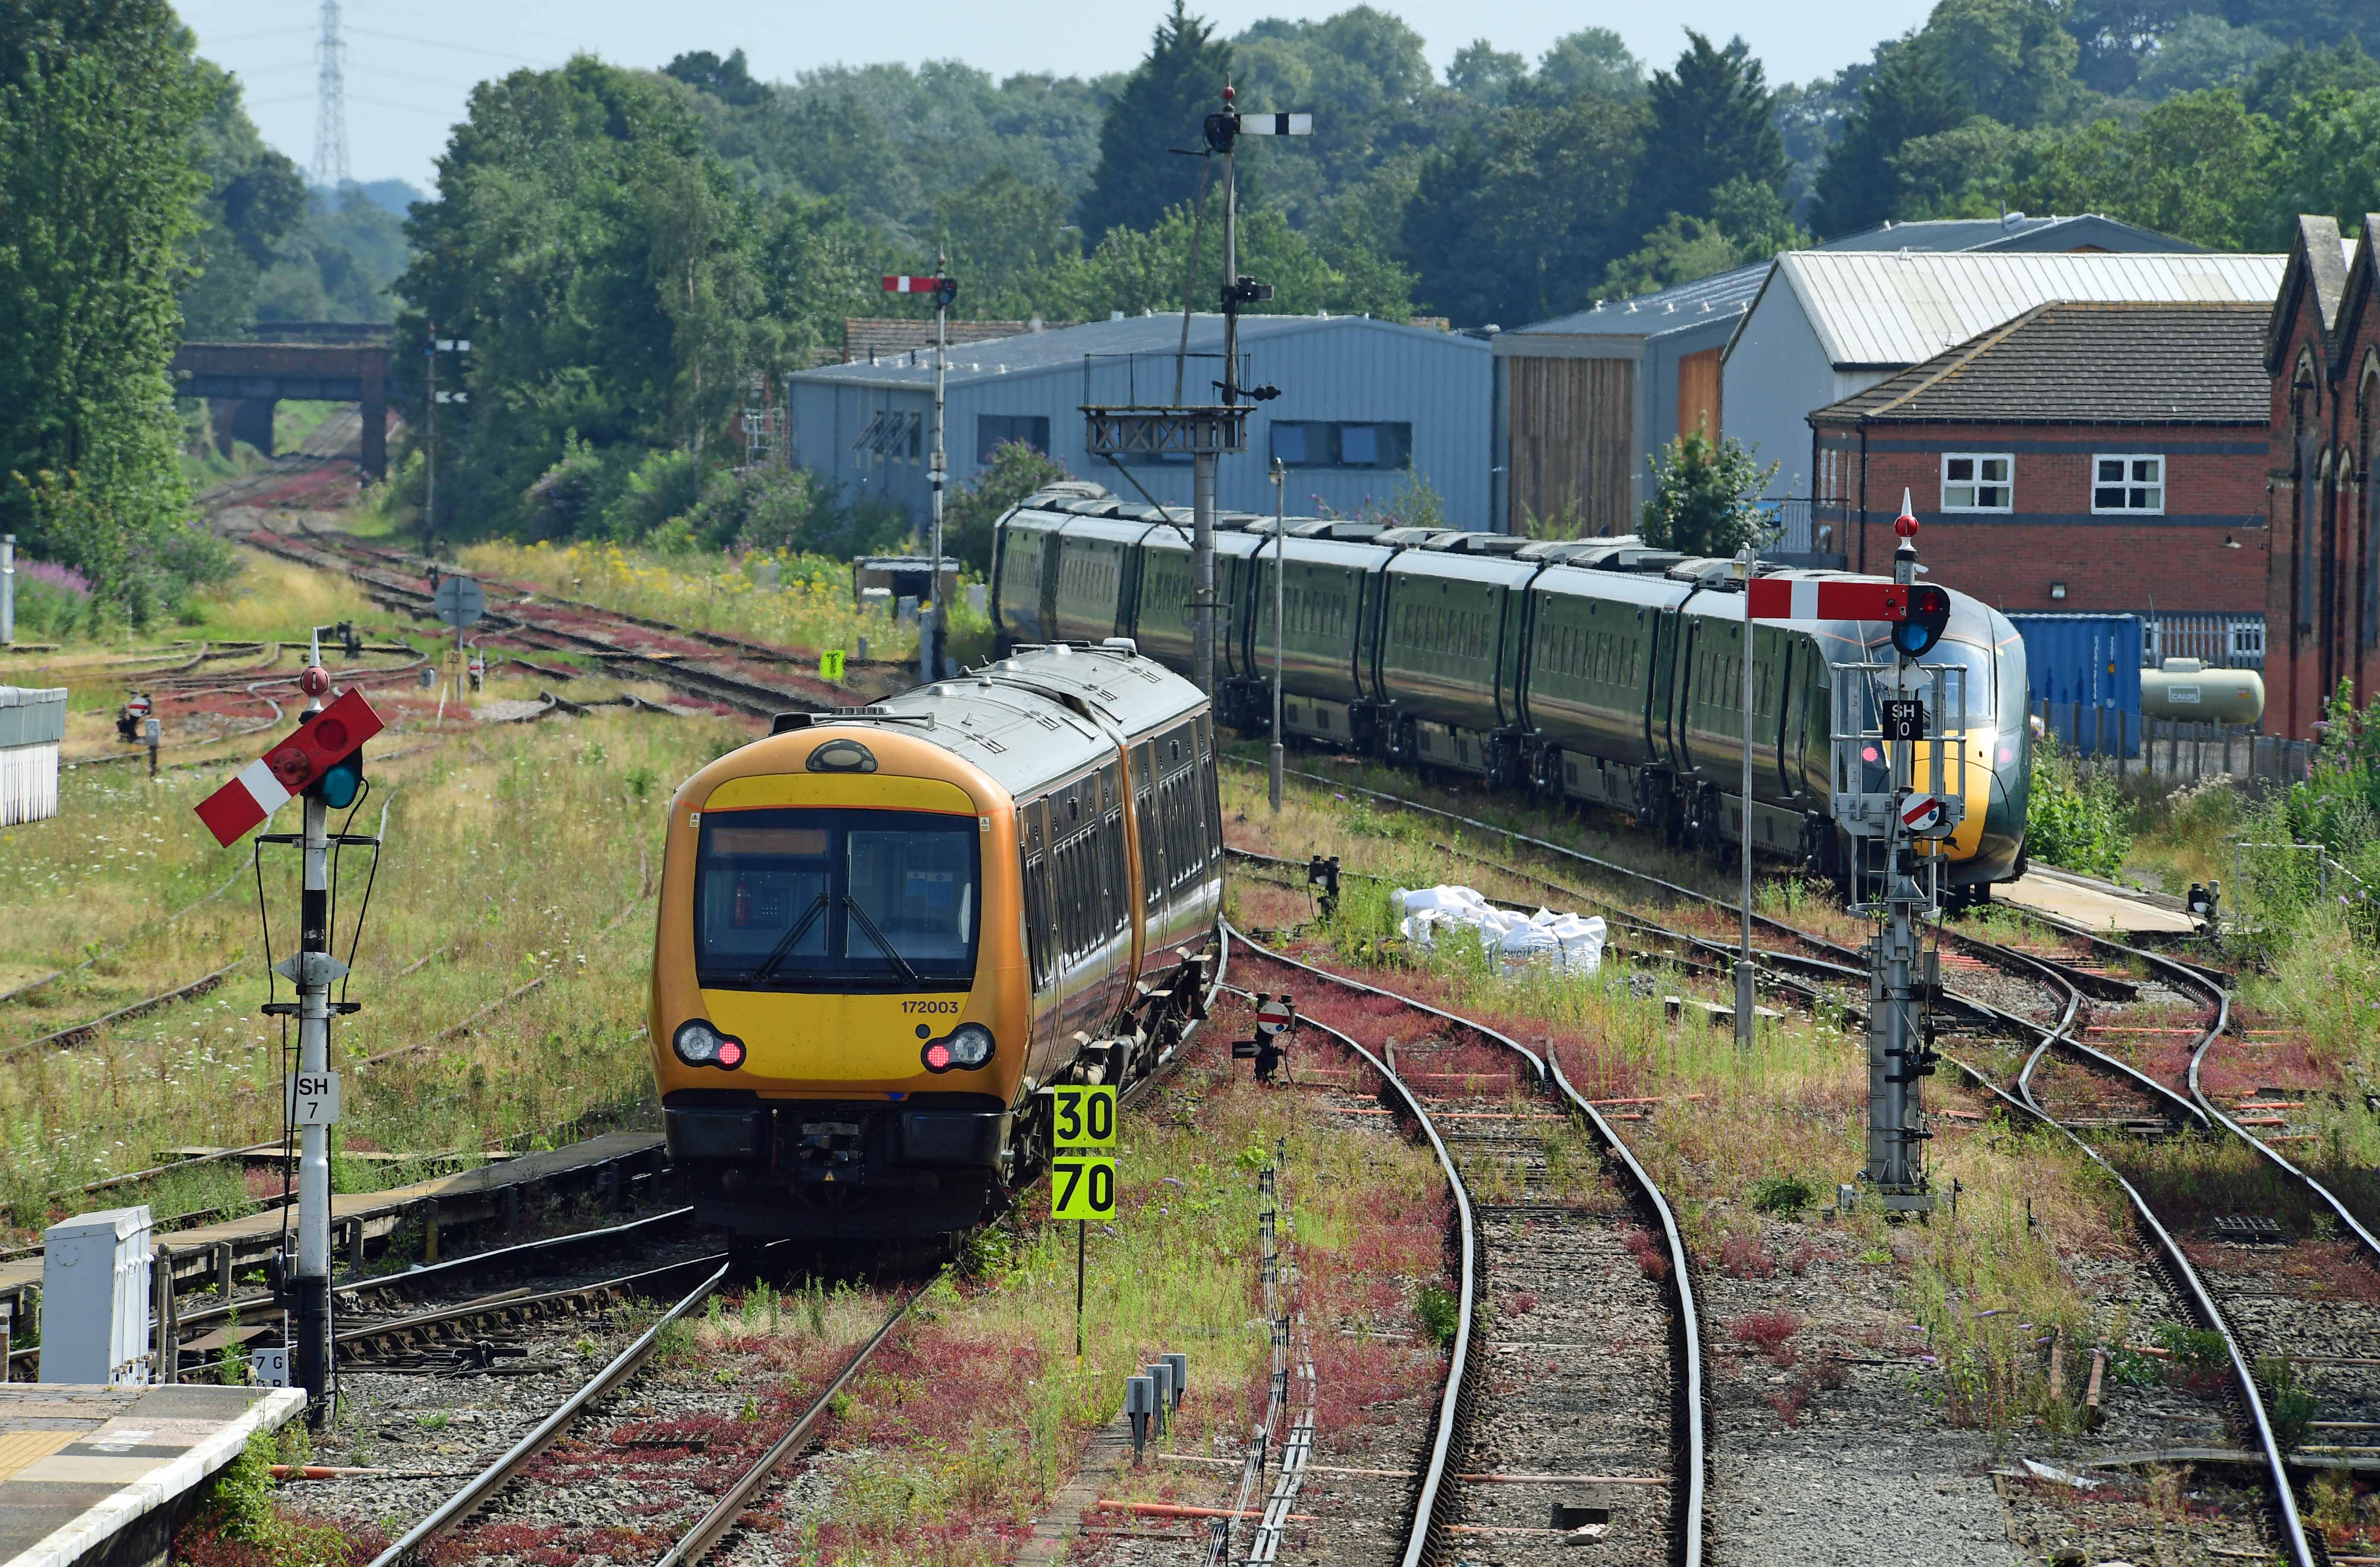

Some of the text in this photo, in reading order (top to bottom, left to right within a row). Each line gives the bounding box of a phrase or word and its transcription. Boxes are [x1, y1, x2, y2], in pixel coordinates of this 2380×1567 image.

[1892, 704, 1914, 717] SH
[901, 1001, 958, 1013] 172003
[299, 1078, 327, 1095] SH
[308, 1102, 318, 1119] 7
[1057, 1092, 1112, 1140] 30
[1054, 1164, 1113, 1212] 70
[256, 1356, 283, 1370] 7 G
